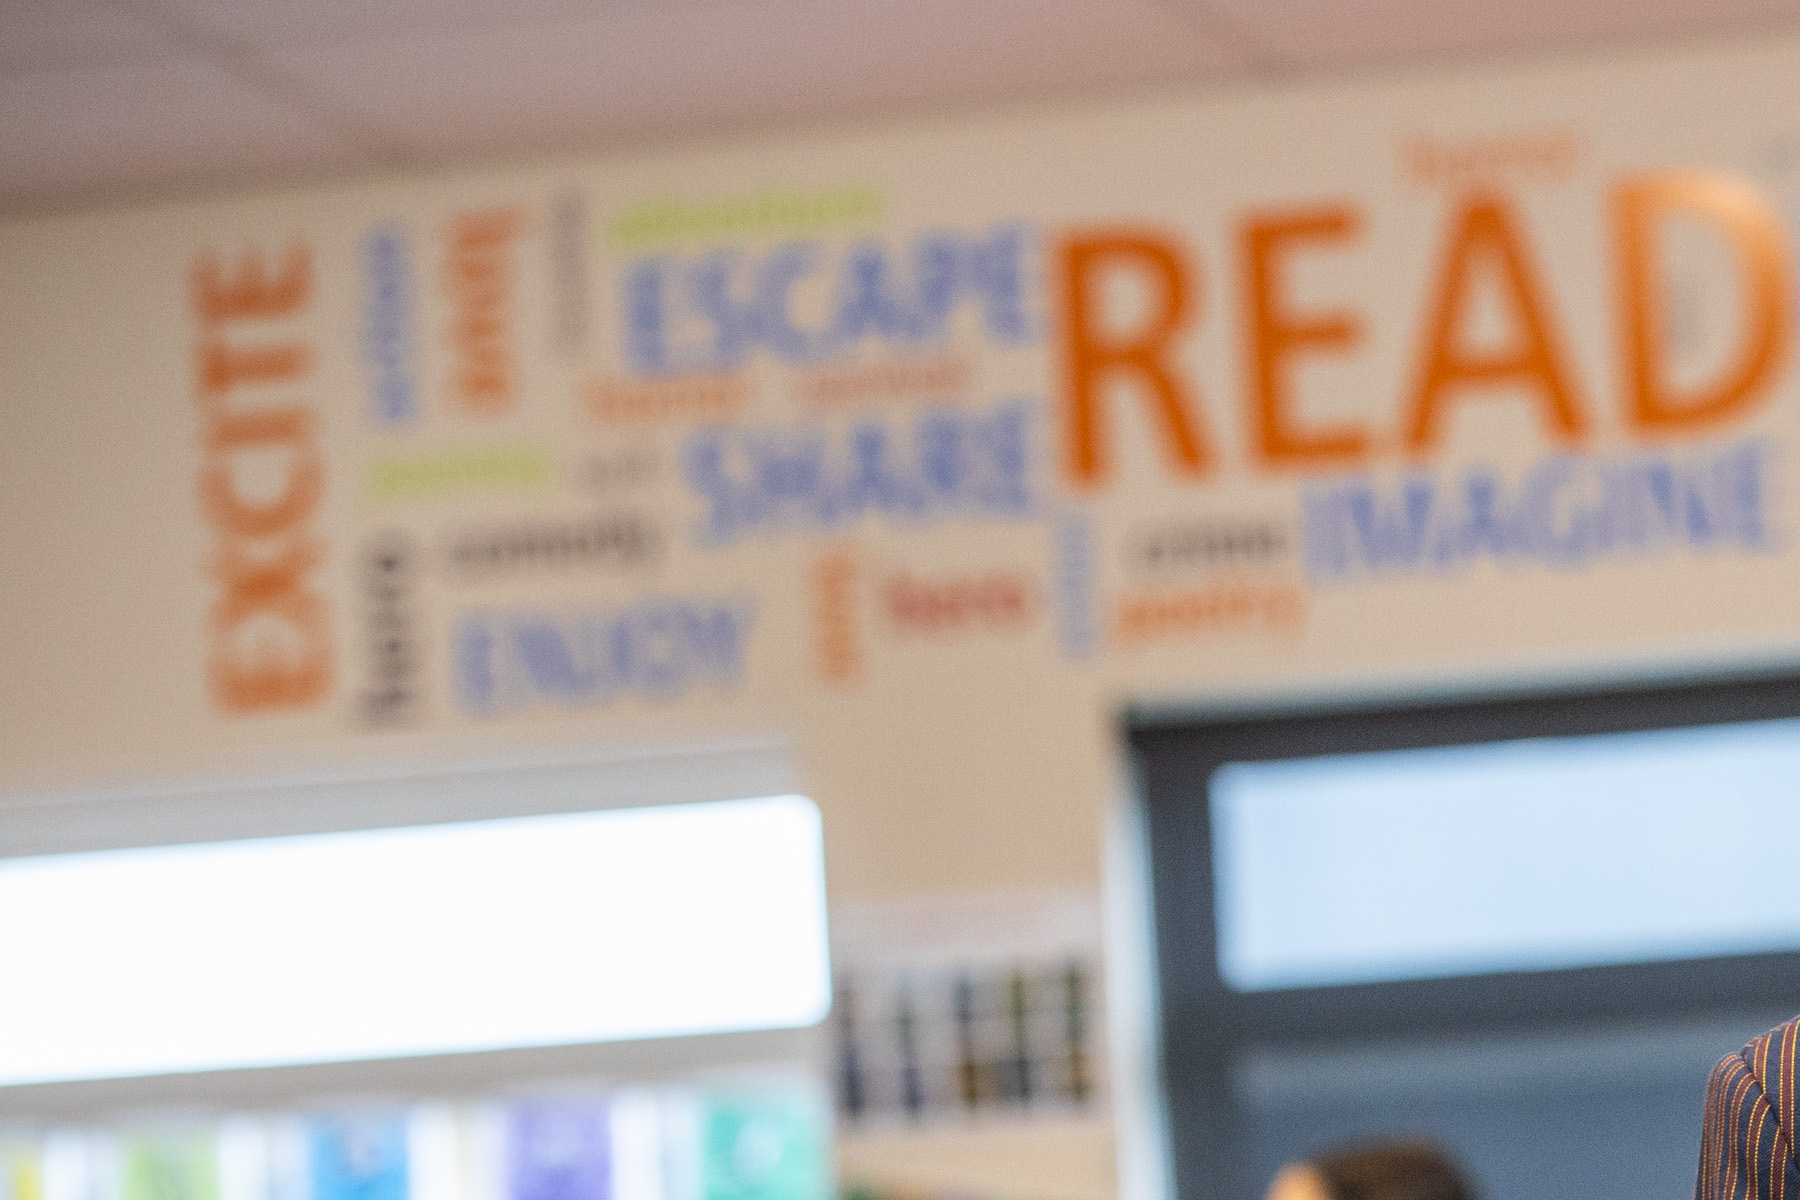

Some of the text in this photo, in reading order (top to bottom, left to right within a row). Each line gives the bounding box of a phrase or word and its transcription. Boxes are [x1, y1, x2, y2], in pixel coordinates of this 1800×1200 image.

[620, 224, 1034, 378] ESCAPE
[1057, 168, 1797, 488] READ
[193, 238, 334, 712] EXCITE
[682, 400, 1031, 548] SHARE
[1303, 440, 1772, 580] IMAGINE
[457, 592, 752, 716] ENJOY
